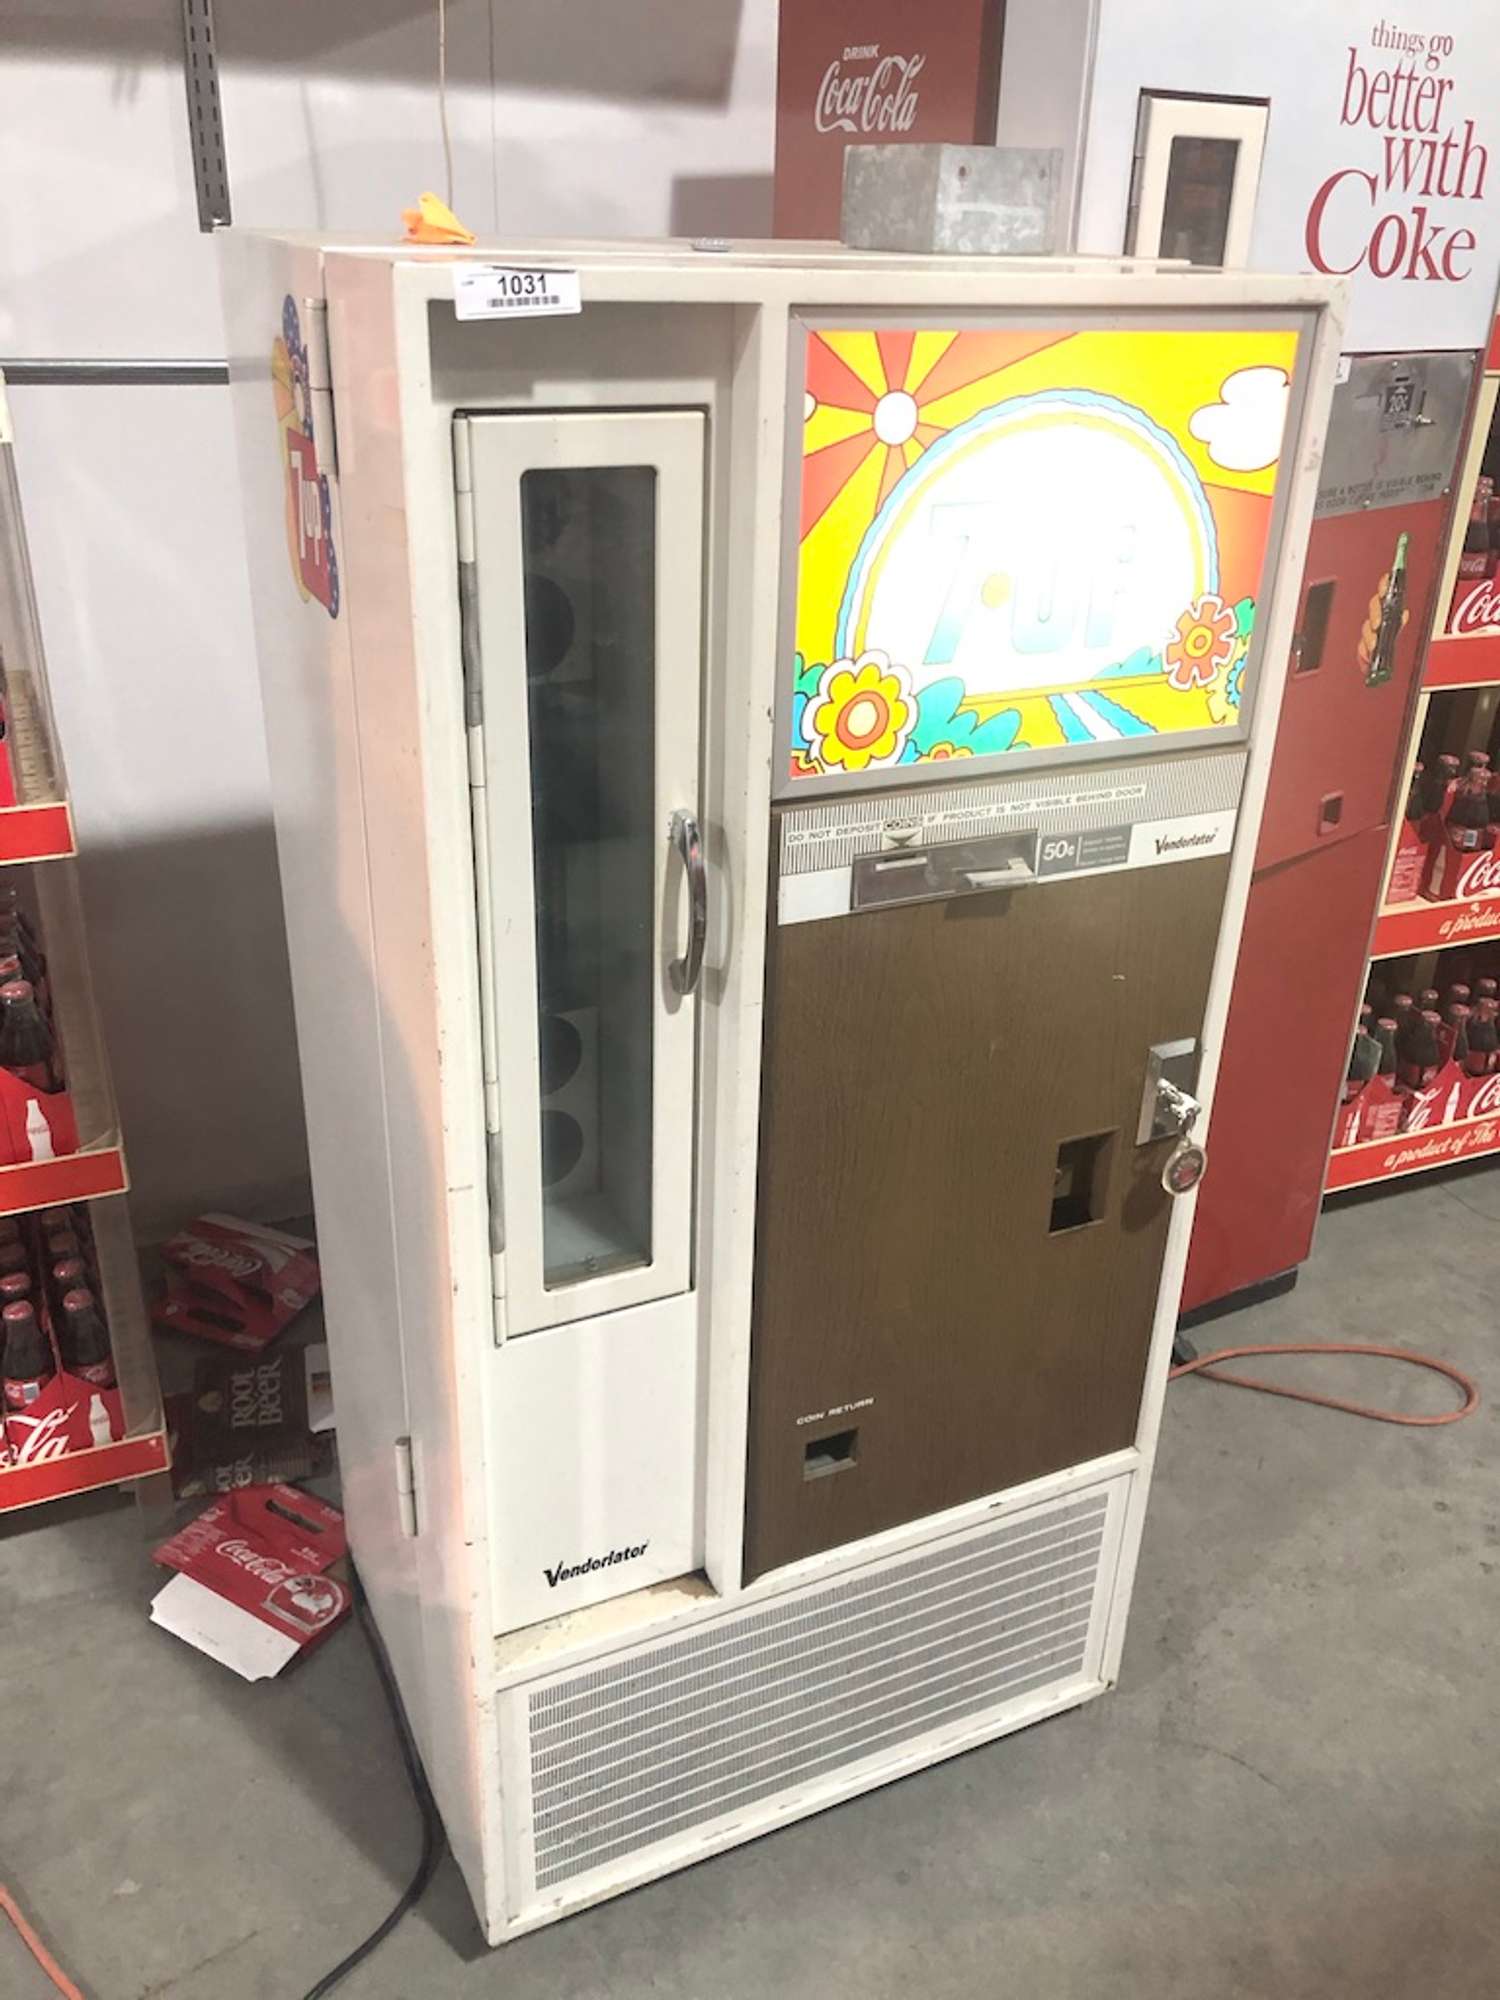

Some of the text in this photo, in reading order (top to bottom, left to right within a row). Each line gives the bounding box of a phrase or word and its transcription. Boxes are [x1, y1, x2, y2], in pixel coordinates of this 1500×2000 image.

[842, 44, 880, 61] DRINK
[1371, 19, 1454, 72] things go
[815, 53, 926, 133] Coca-Cola
[1340, 46, 1454, 134] better
[1383, 119, 1489, 200] with
[1305, 169, 1477, 282] Coke
[497, 273, 549, 297] 1031
[788, 833, 804, 844] DO
[809, 829, 832, 841] NOT
[835, 822, 880, 837] DEPOSIT
[943, 806, 991, 821] PRODUCT
[1010, 802, 1031, 812] NOT
[1035, 797, 1072, 809] VISIBLE
[1075, 791, 1113, 803] BEHIND
[1115, 786, 1143, 797] DOOR
[1391, 1137, 1452, 1172] product
[1449, 1130, 1471, 1155] of
[1468, 1120, 1498, 1147] The
[796, 1397, 875, 1426] COIN RETURN
[543, 1541, 650, 1588] Vendorlator
